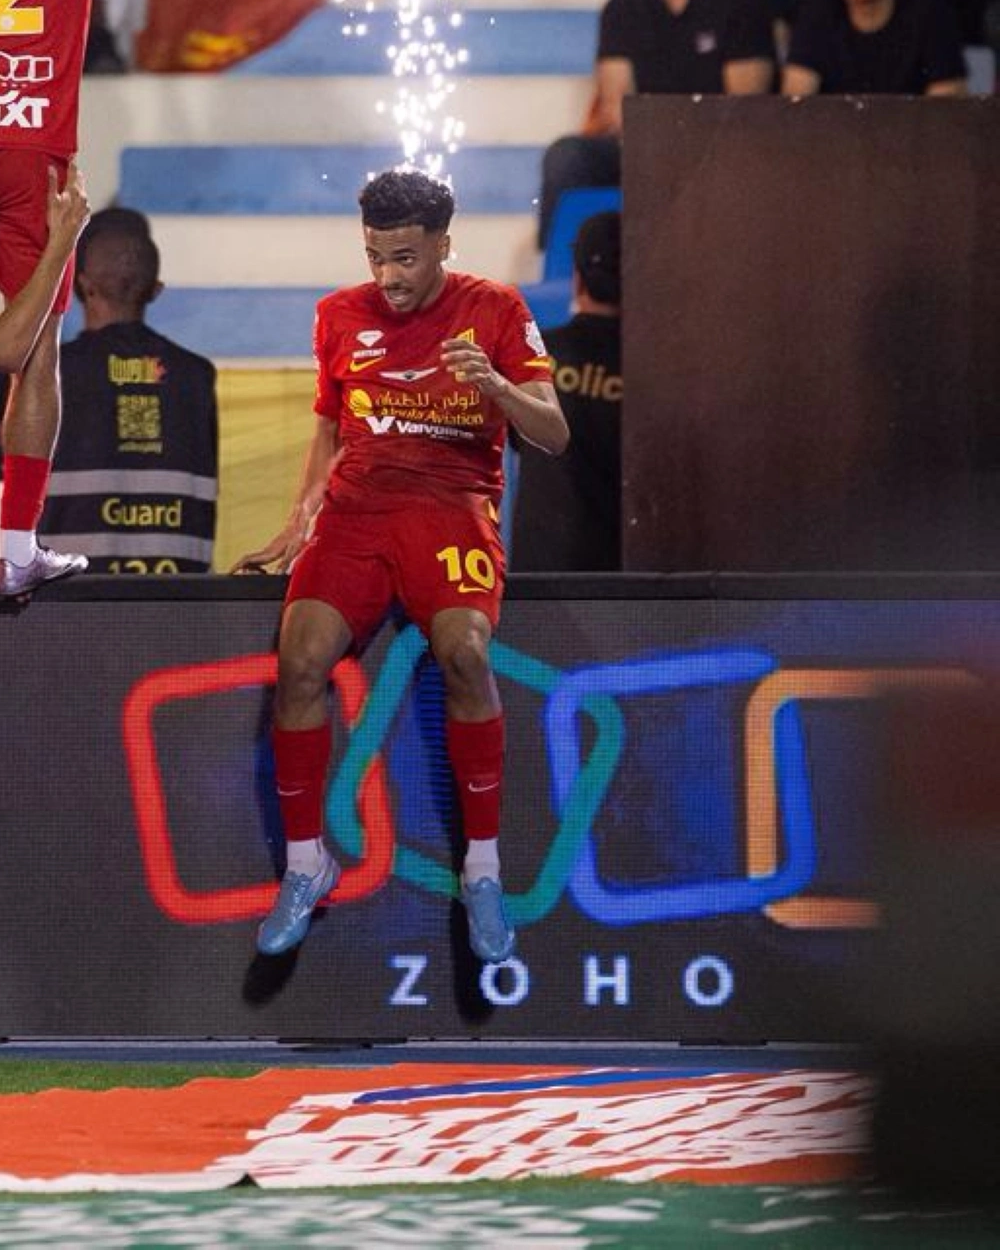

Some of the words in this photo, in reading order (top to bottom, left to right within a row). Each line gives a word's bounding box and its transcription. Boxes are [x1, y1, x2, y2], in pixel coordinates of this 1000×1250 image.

[549, 357, 624, 401] olic
[102, 497, 182, 527] Guard
[436, 546, 496, 589] 10
[389, 955, 734, 1005] ZOHO
